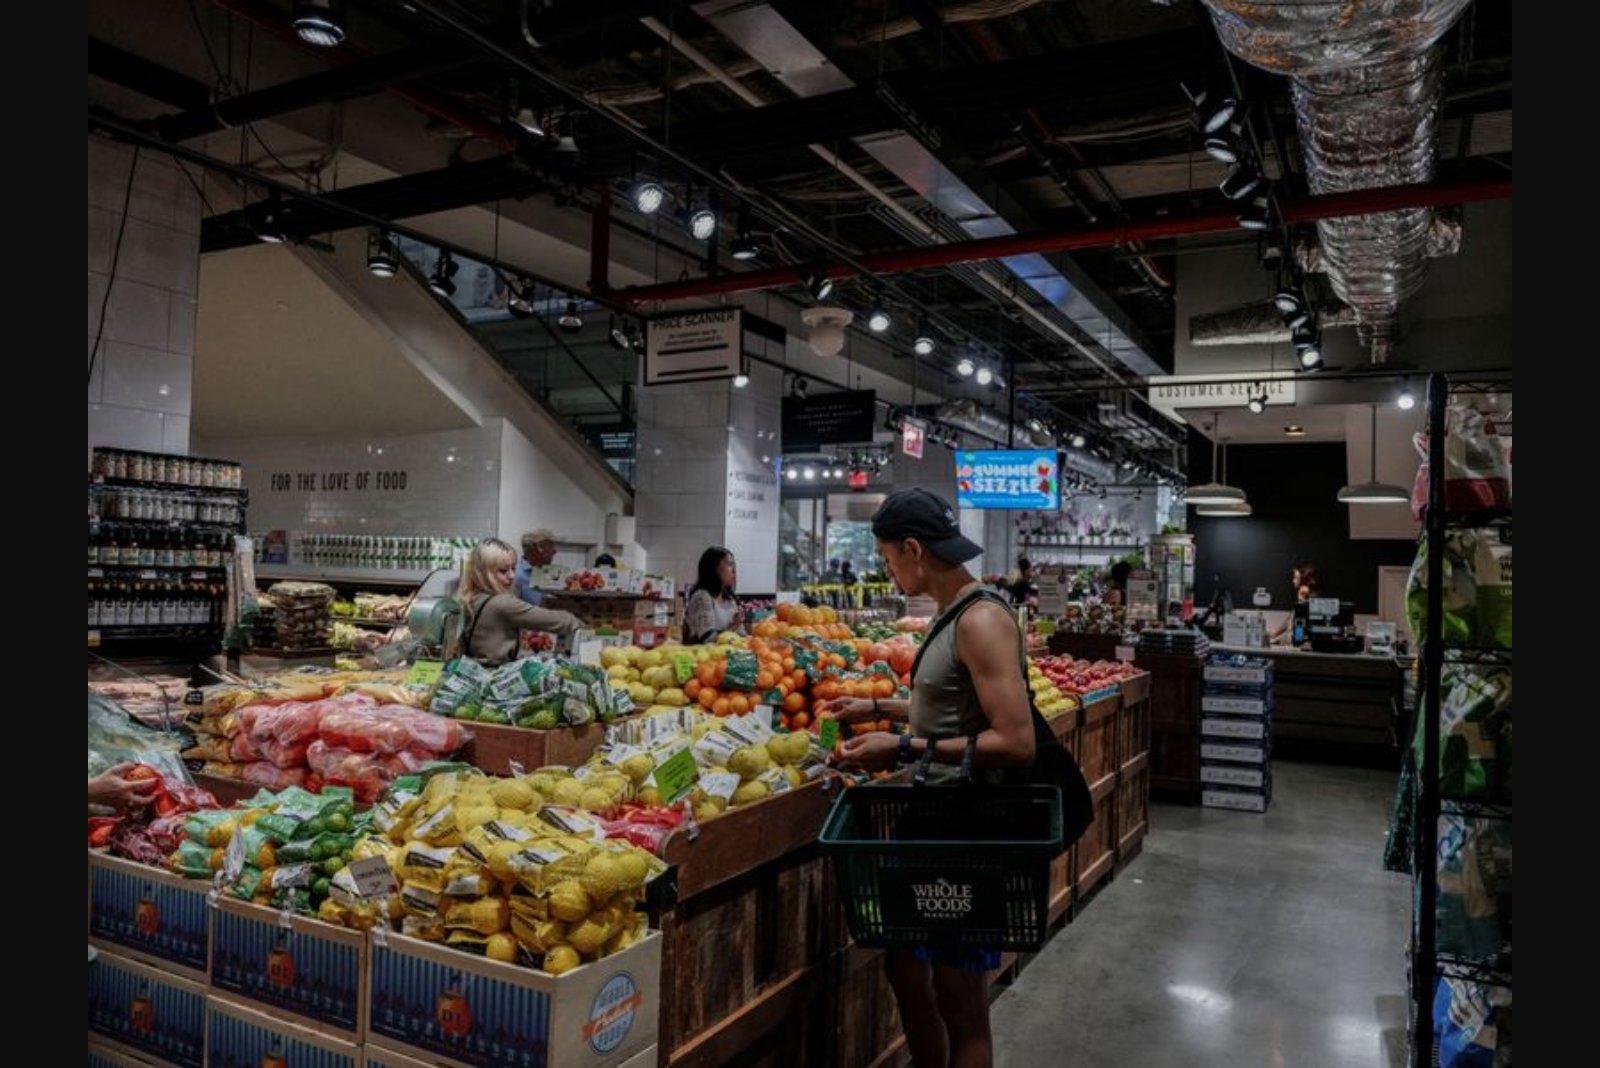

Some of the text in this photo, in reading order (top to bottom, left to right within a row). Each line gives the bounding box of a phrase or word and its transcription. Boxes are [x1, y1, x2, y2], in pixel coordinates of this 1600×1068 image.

[1159, 384, 1223, 398] CUSTOMER
[271, 471, 407, 491] FOR THE LOVE OF FOOD
[973, 478, 1042, 496] SIZZLE
[912, 883, 974, 898] WHOLE
[917, 898, 972, 912] FOODS
